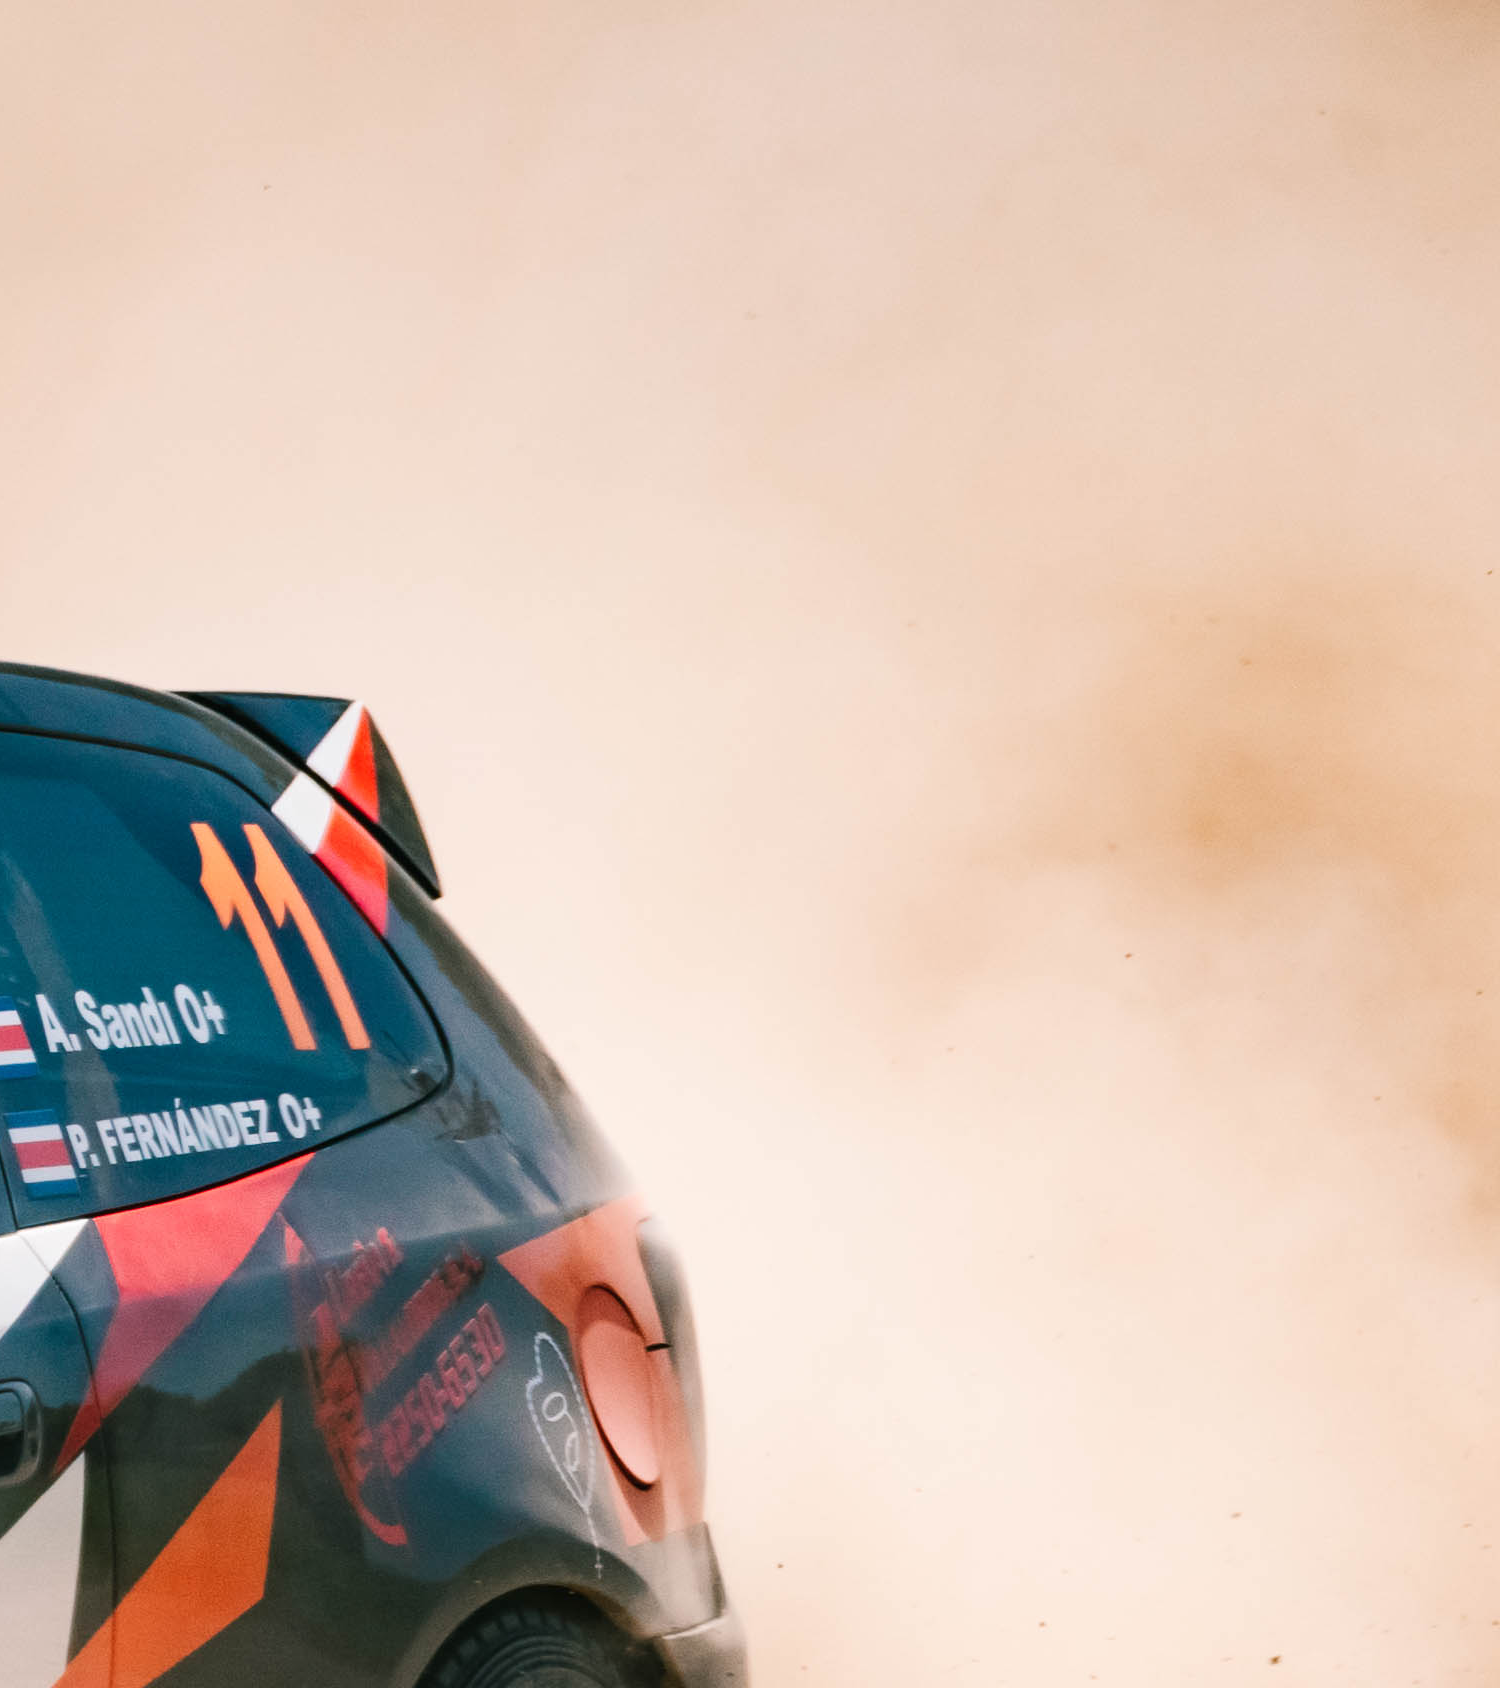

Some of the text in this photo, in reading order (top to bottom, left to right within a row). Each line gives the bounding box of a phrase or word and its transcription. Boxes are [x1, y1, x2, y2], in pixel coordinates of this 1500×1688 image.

[190, 821, 372, 1051] 11
[35, 993, 82, 1053] A.
[65, 1123, 100, 1169] P.
[96, 1097, 280, 1166] FERNÁNDEZ
